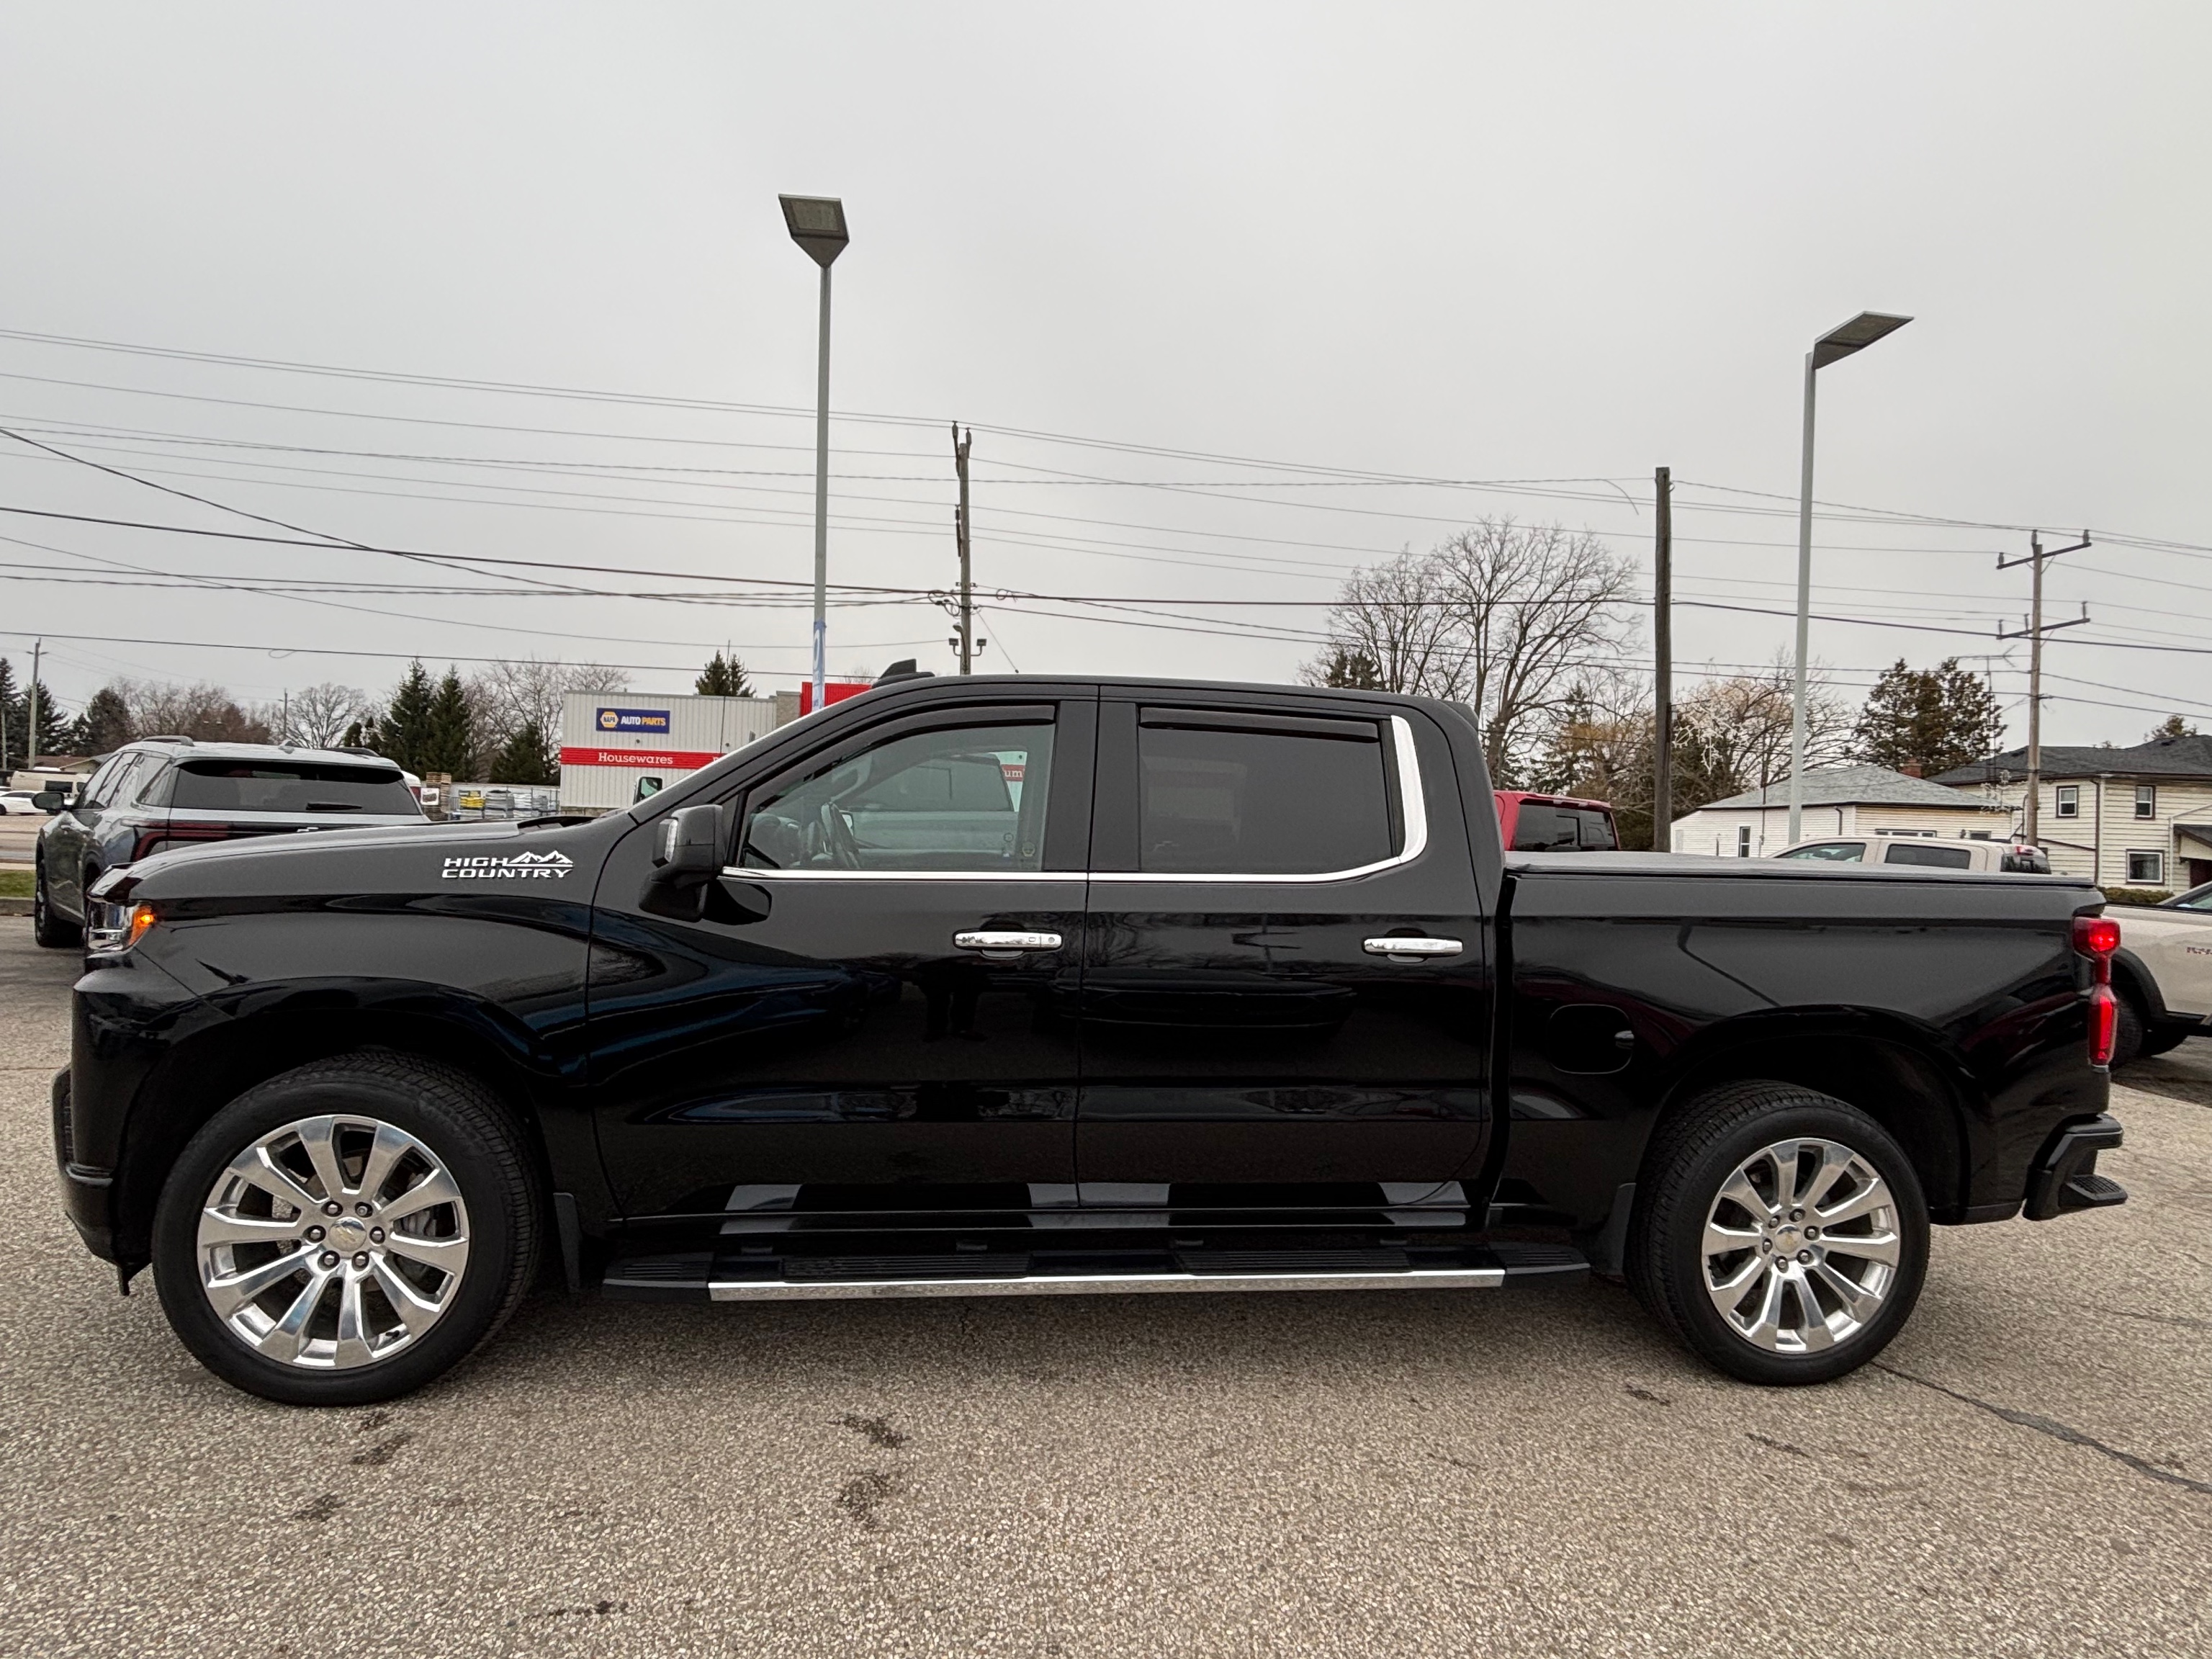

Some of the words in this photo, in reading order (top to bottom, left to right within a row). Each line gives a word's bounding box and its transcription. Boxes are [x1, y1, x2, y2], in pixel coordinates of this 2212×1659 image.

[621, 716, 641, 724] AUTO
[642, 717, 665, 726] PARTS
[598, 752, 673, 764] Housewares
[1002, 768, 1024, 778] um
[444, 858, 508, 867] HIGH
[441, 868, 573, 878] COUNTRY
